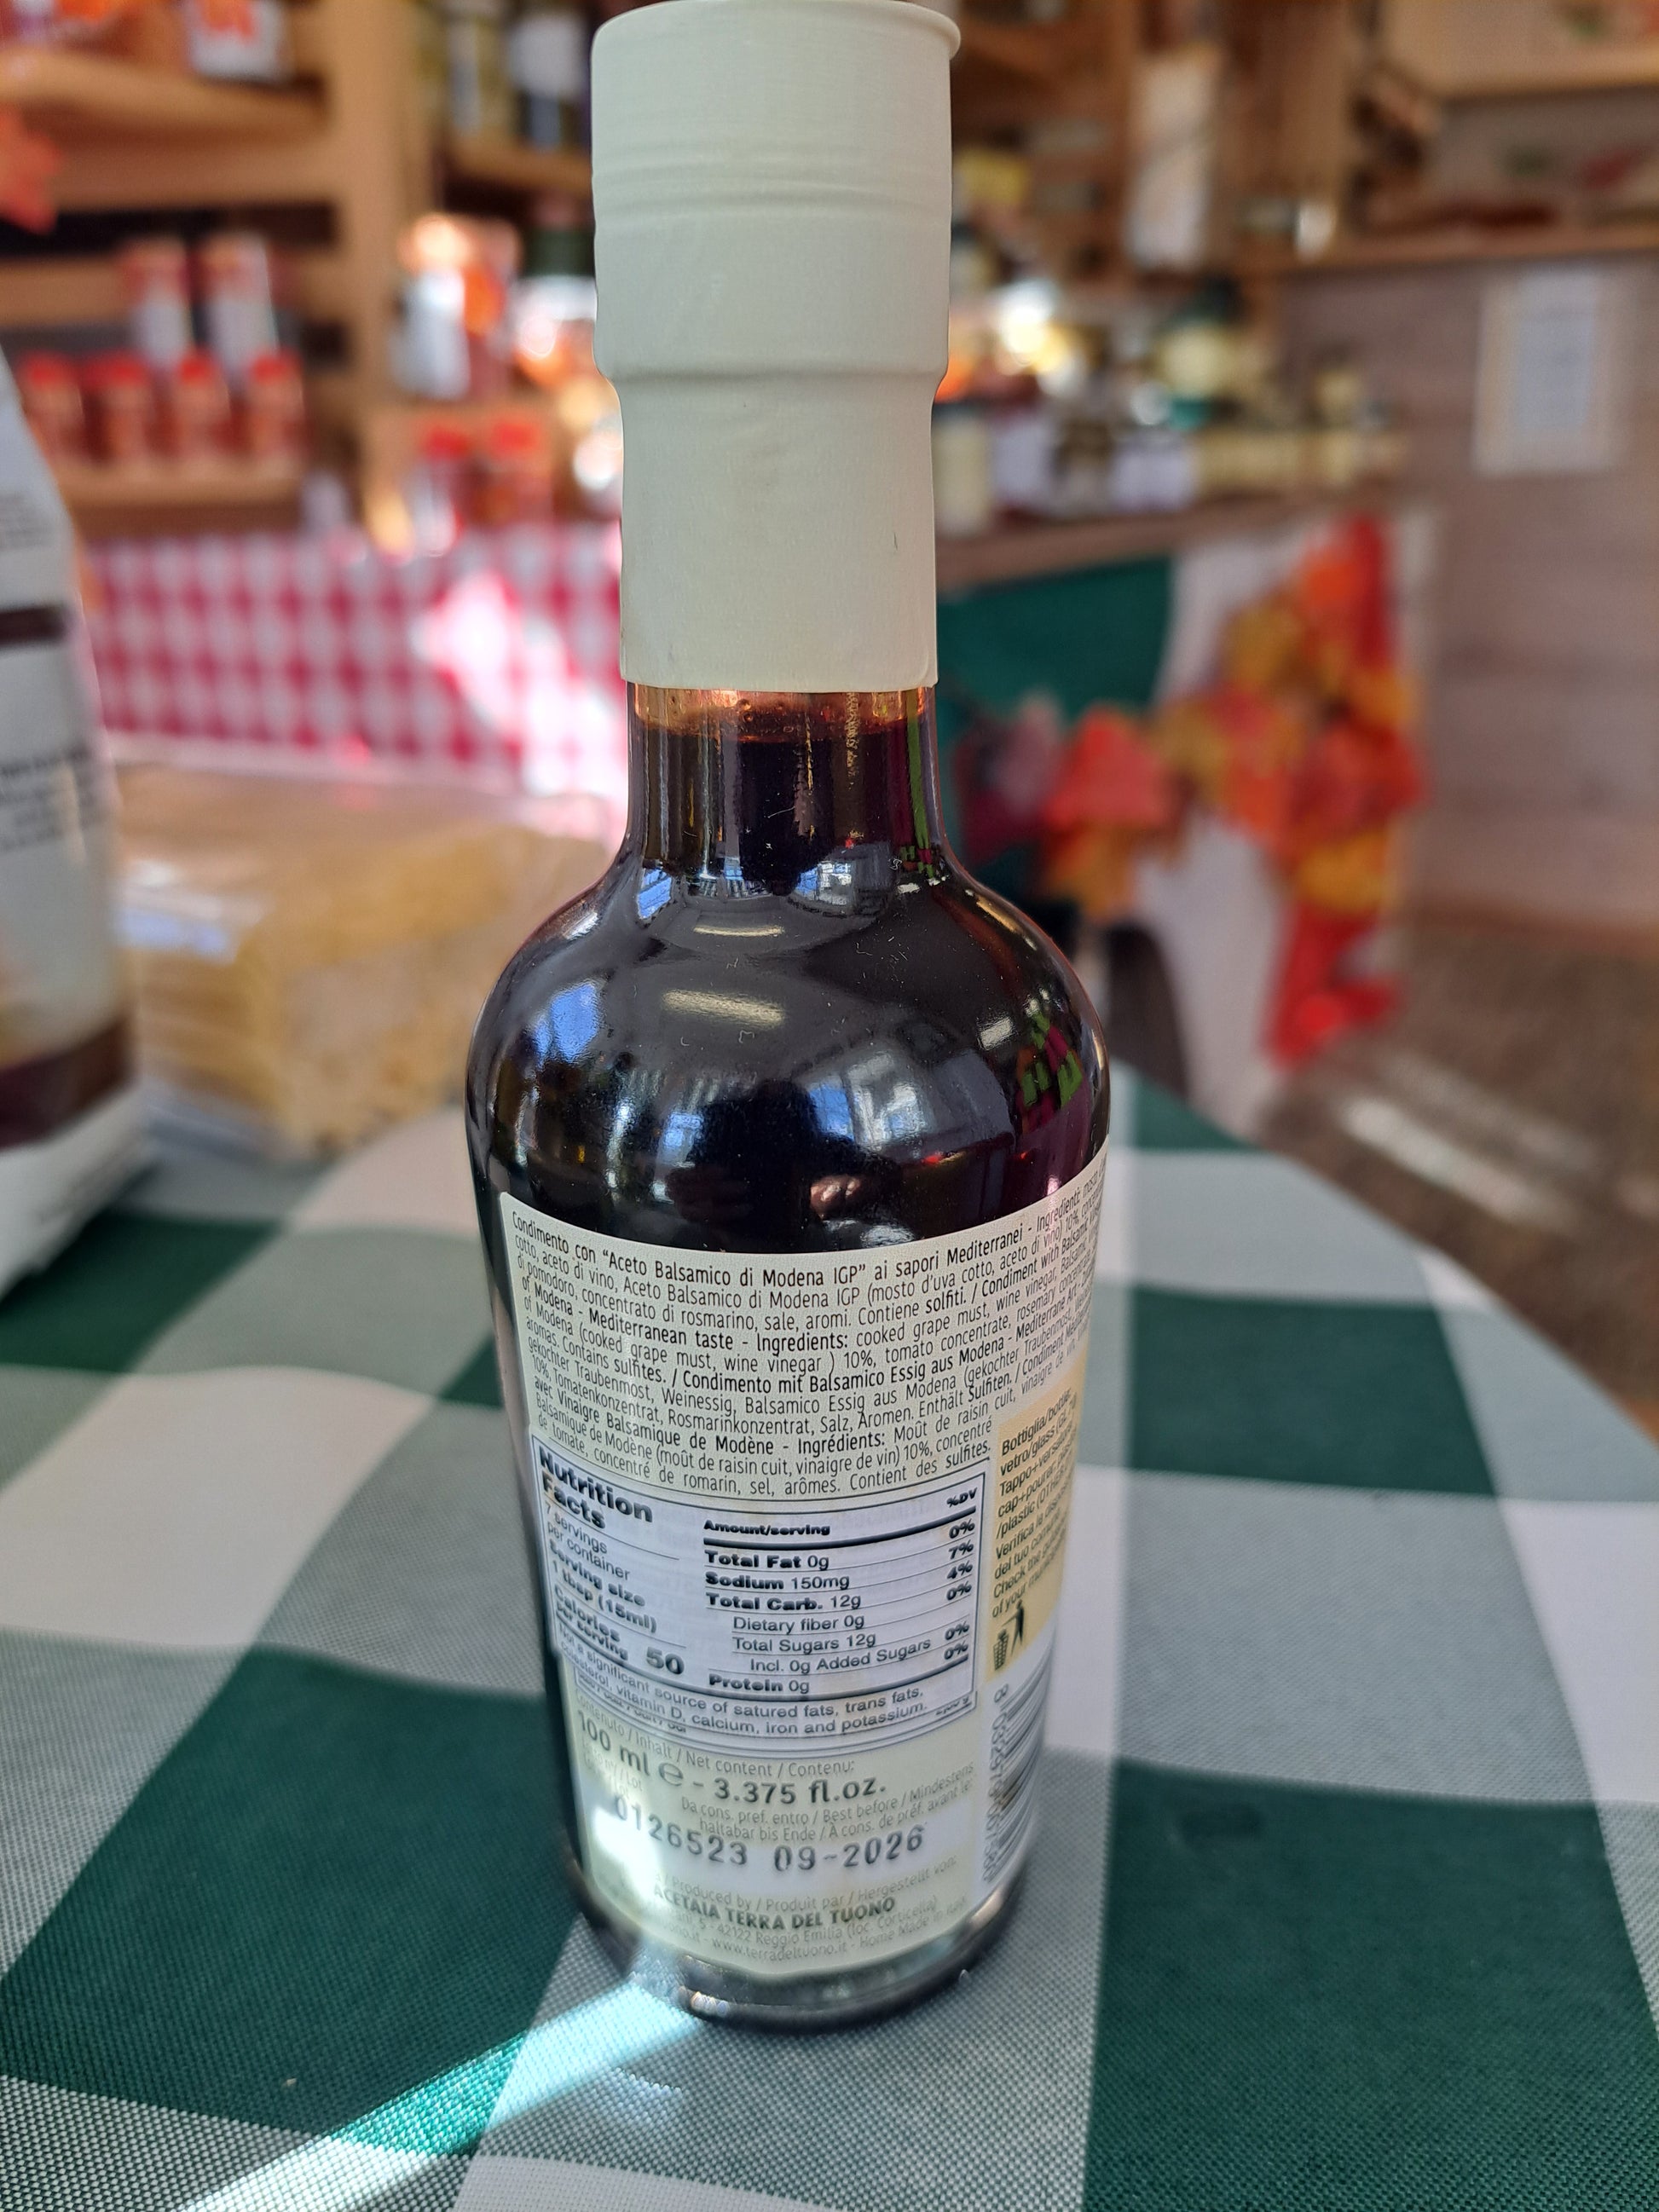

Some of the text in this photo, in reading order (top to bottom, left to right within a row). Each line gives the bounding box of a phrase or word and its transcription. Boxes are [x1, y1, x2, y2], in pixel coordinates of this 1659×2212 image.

[541, 1249, 995, 1308] aceto vino, Aceto Balsamico Modena IGP (mosto d’uva cotto,
[574, 1223, 1023, 1286] con “Aceto Balsamico Modena IGP” sapori Mediterranei
[527, 1261, 966, 1332] pomodoro, concentrato rosmarino, sale, aromi. Contiene solfiti.
[534, 1280, 990, 1355] Modena Mediterranean taste Ingredients: cooked grape must,
[535, 1300, 1011, 1376] Modena (cooked grape must, wine vinegar 10%, tomato concentrate,
[562, 1334, 1004, 1393] Contains sulfites. Condimento mit Balsamico Essig aus Modena
[528, 1334, 1019, 1417] gekochter Traubenmost, Weinessig, Balsamico Essig aus Modena (gekochter
[552, 1363, 1012, 1438] Tomatenkonzentrat, Rosmarinkonzentrat, Salz, Aromen. Enthält Sulfiten.
[536, 1391, 992, 1477] Balsamique Modène (moût raisin cuit, vinaigre vin) 10%, concentré
[556, 1386, 1015, 1457] Vinaigre Balsamique Modène Ingrédients: Moût raisin cuit,
[540, 1445, 653, 1522] Nutrition
[552, 1419, 991, 1497] tomate, concentré romarin, sel, arômes. Contient des sulfites.
[541, 1470, 606, 1528] Facts
[703, 1520, 830, 1536] Amount/serving
[554, 1512, 607, 1554] servings
[567, 1539, 630, 1580] container
[704, 1518, 975, 1570] Total Fat 0g 0%
[705, 1539, 974, 1590] Sodium 150mg 7%
[706, 1560, 973, 1611] Total Carb. 12g 4%
[608, 1583, 645, 1607] size
[733, 1580, 972, 1635] Dietary fiber 0g 0%
[555, 1584, 685, 1675] Calories 50
[732, 1634, 876, 1655] Total Sugars 12g
[750, 1638, 931, 1675] Incl. 0g Added Sugars
[587, 1651, 886, 1718] significant source satured fats, trans
[616, 1686, 666, 1714] vitamin
[691, 1715, 760, 1734] calcium,
[766, 1721, 798, 1734] iron
[804, 1719, 835, 1734] and
[841, 1703, 927, 1732] potassium.
[708, 1673, 810, 1694] Protein 0g
[578, 1710, 610, 1751] 100
[620, 1745, 650, 1776] ml
[714, 1777, 796, 1805] 3.375
[809, 1777, 886, 1804] fl.oz.
[635, 1731, 855, 1777] Inhalt Net content Contenu:
[616, 1794, 925, 1872] 0126523 09-2026
[702, 1797, 898, 1825] cons. pref. Best before
[783, 1827, 816, 1840] Ende
[725, 1906, 785, 1930] TERRA
[791, 1913, 823, 1929] DEL
[829, 1897, 896, 1924] TUONO
